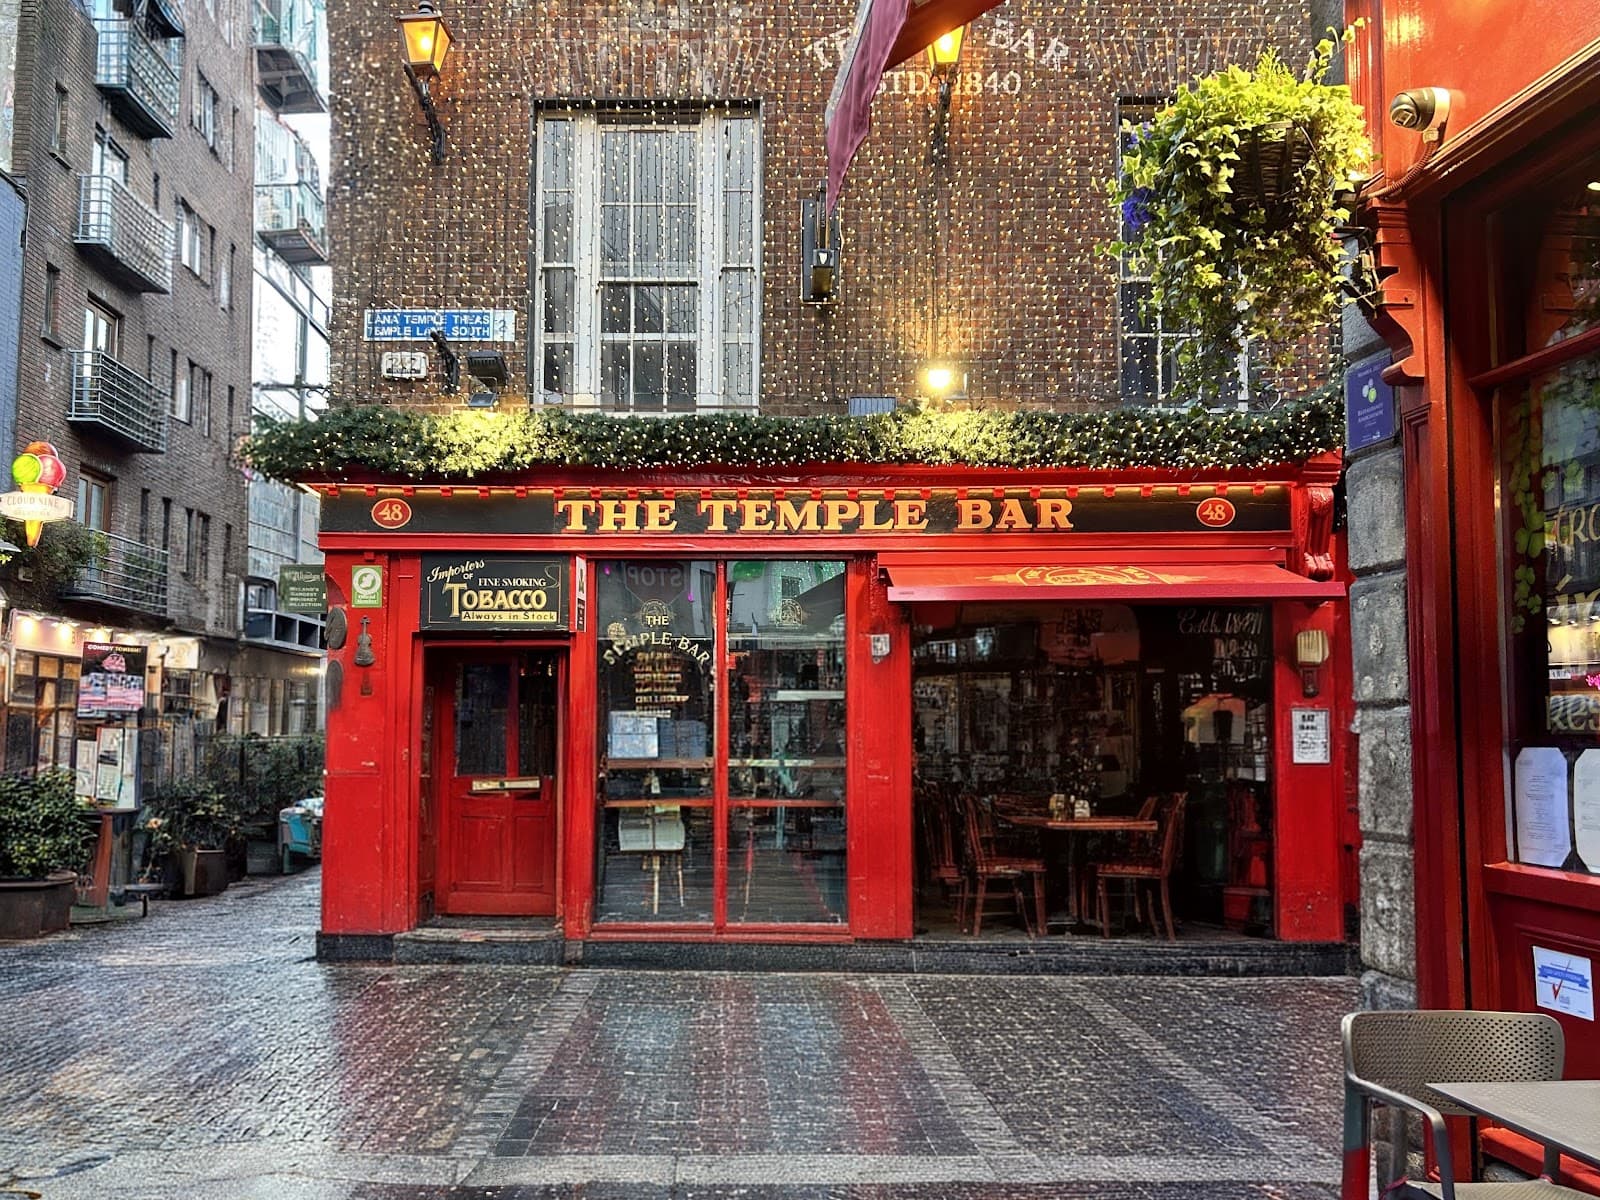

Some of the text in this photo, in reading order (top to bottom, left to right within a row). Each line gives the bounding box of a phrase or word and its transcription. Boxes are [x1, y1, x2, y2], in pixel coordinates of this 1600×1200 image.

[987, 17, 1069, 72] BAR
[404, 314, 446, 325] TEMPLE
[454, 314, 490, 325] THEAS
[367, 327, 411, 337] TEMPLE
[453, 327, 490, 337] SOUTH
[7, 495, 36, 506] CLOUD
[378, 503, 403, 521] 48
[556, 498, 1074, 533] THE TEMPLE BAR
[1202, 503, 1226, 521] 48
[426, 559, 486, 583] Importers
[463, 572, 475, 581] OF
[478, 577, 548, 588] FINE SMOKING
[463, 610, 555, 623] Always in Stock
[645, 615, 670, 626] THE
[87, 644, 113, 652] COMEDY
[677, 636, 710, 666] BAR
